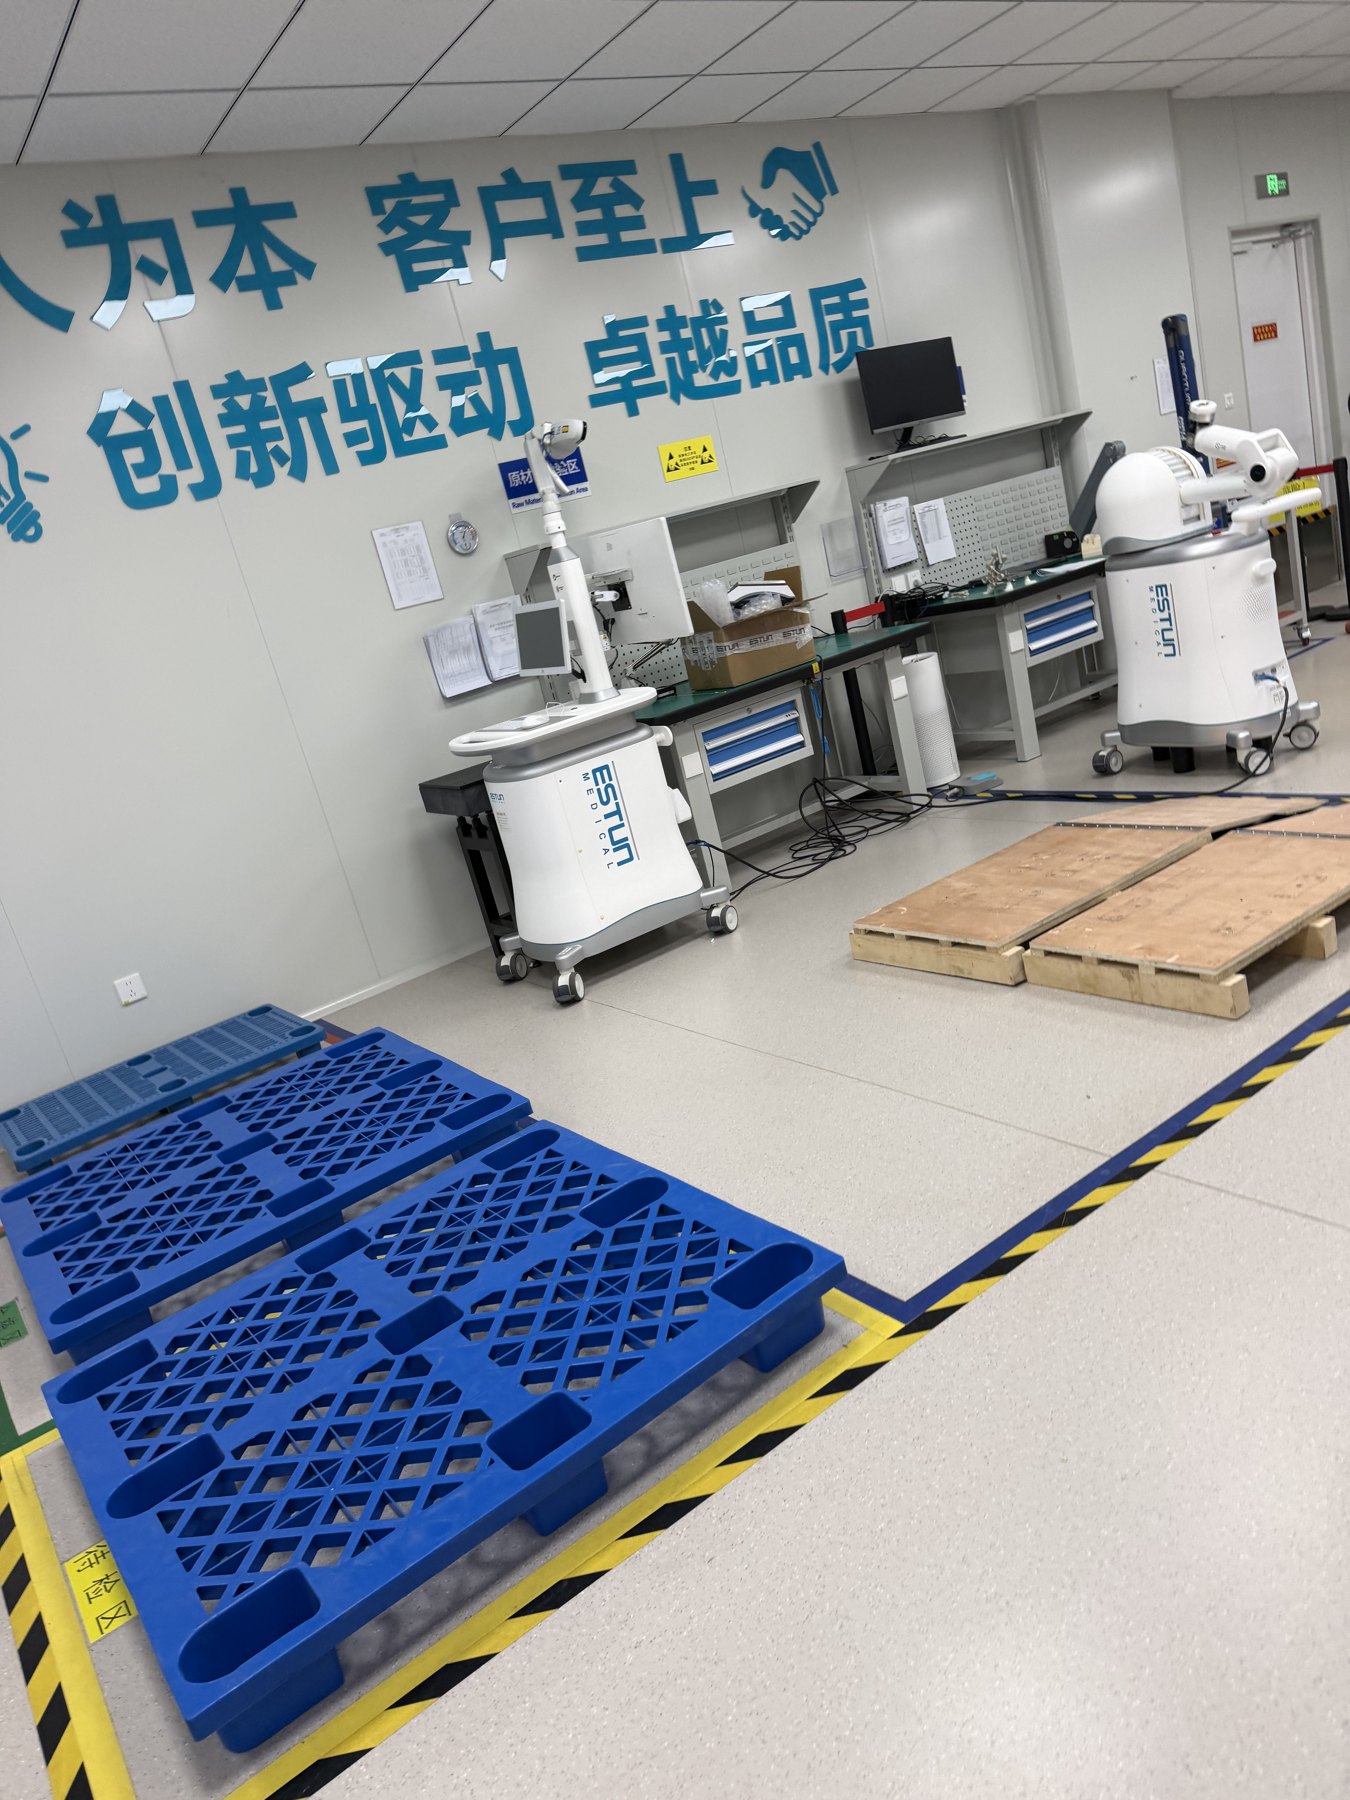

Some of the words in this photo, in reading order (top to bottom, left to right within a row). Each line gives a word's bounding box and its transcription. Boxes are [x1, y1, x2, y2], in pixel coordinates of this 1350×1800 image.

[364, 152, 735, 293] 客户至上
[86, 331, 535, 510] 创新驱动
[583, 277, 875, 418] 卓越品质
[507, 458, 581, 488] 原材验区
[749, 634, 773, 645] ESTUN
[782, 627, 806, 638] ESTUN
[1148, 585, 1163, 657] MEDICAL
[1155, 583, 1177, 658] ESTUN
[582, 772, 614, 869] MEDICAL
[591, 763, 634, 867] ESTUN
[73, 1545, 132, 1635] 待检区
